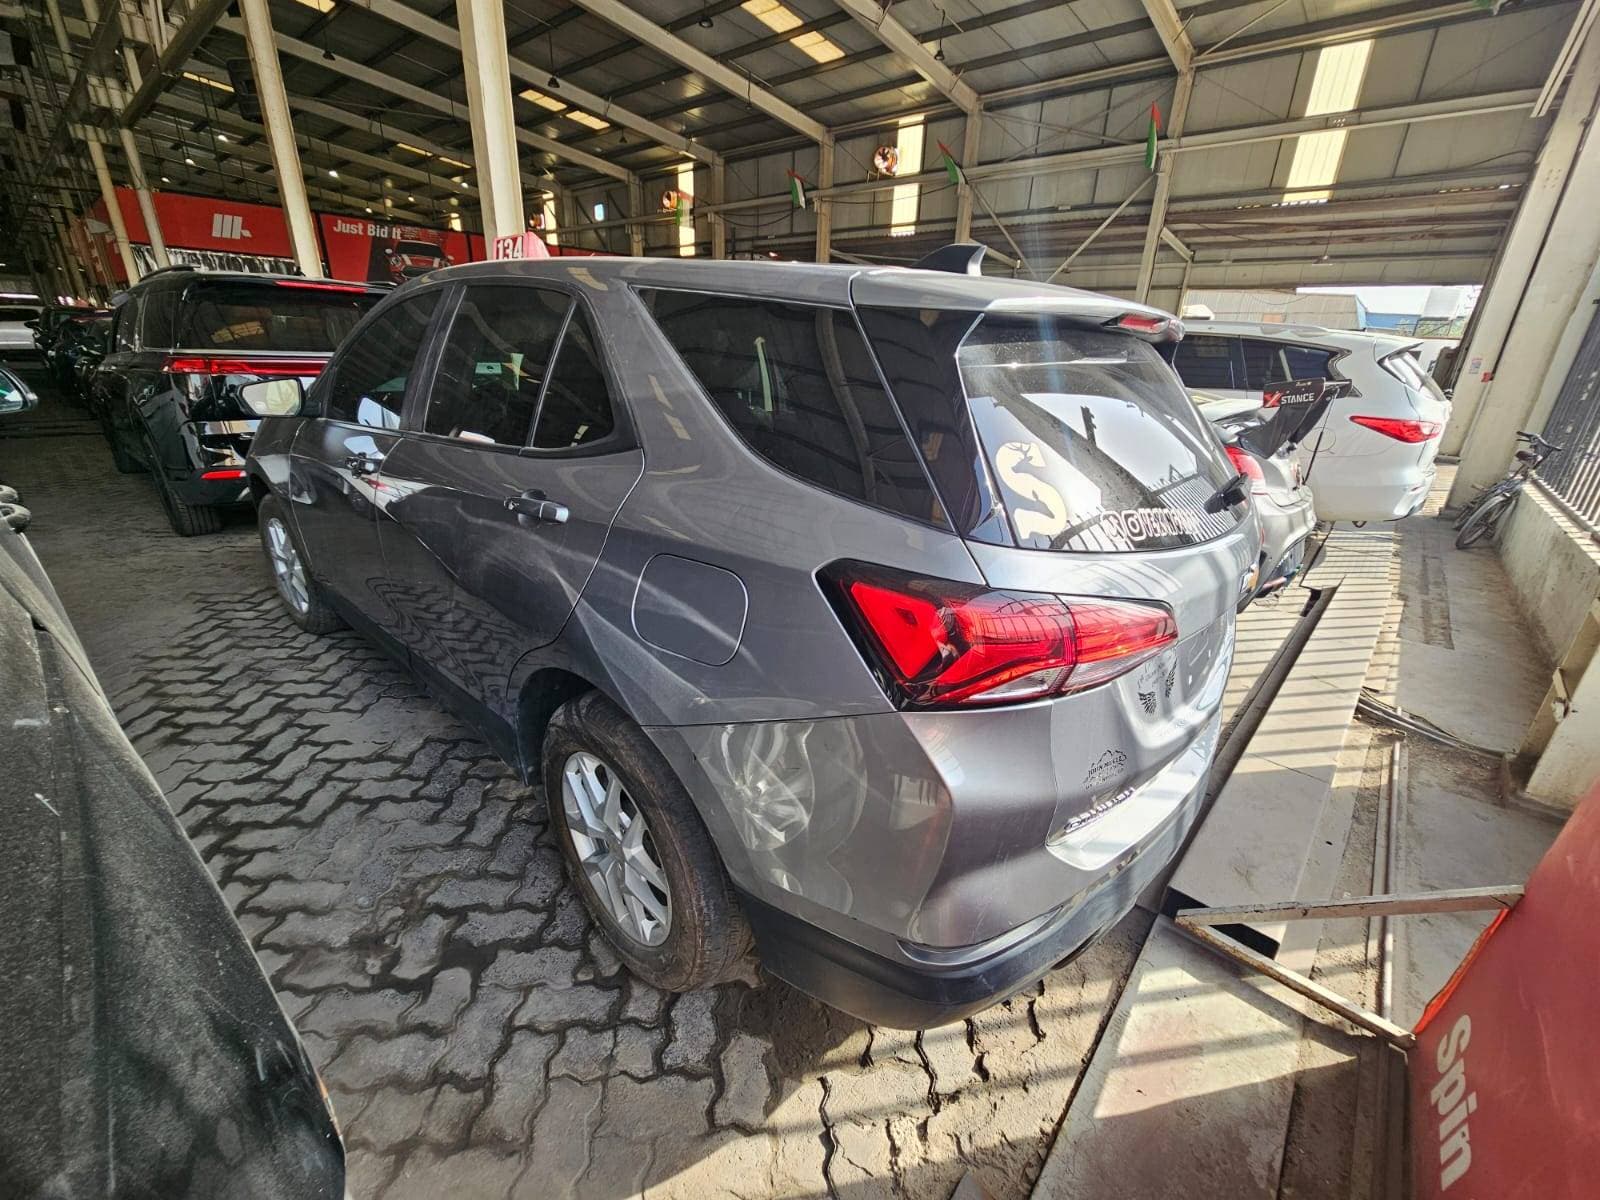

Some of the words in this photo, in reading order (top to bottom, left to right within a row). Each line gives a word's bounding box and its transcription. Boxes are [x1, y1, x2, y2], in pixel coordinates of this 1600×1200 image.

[333, 219, 364, 236] Just
[367, 223, 389, 238] Bid
[391, 226, 402, 240] It
[497, 236, 523, 260] 134
[1281, 393, 1316, 405] STANCE
